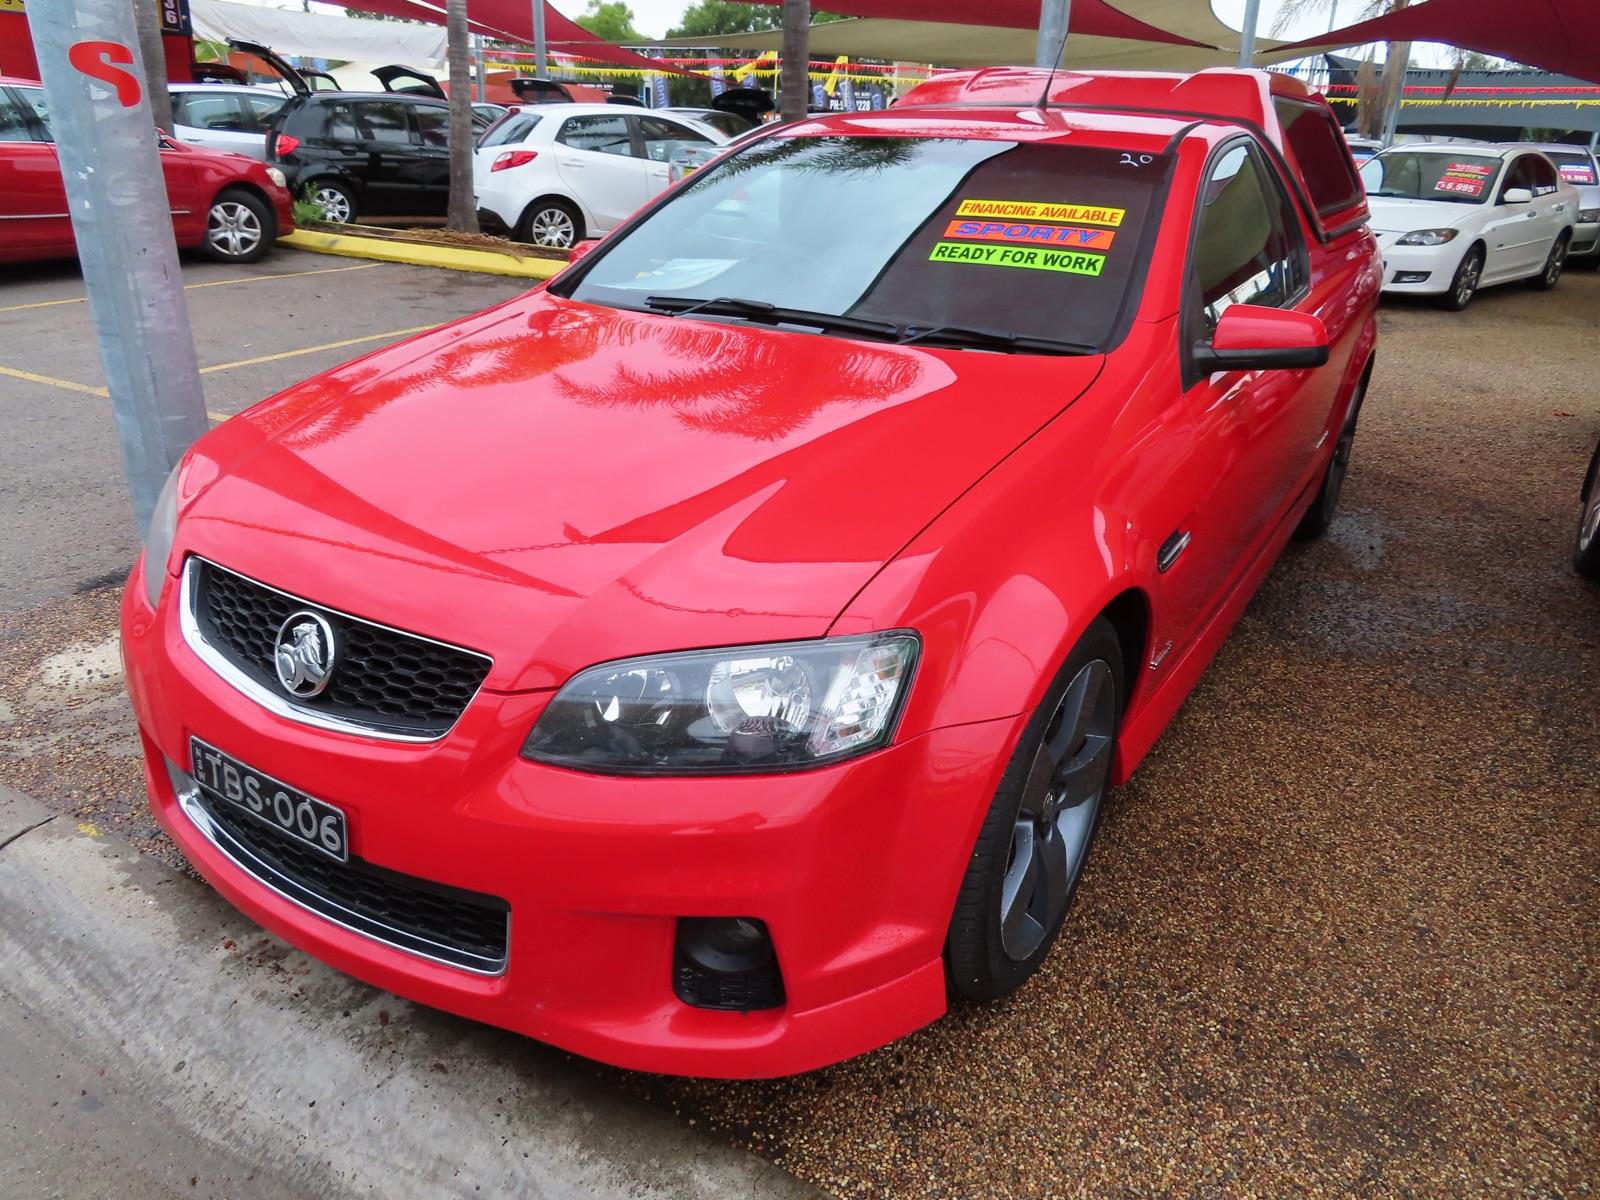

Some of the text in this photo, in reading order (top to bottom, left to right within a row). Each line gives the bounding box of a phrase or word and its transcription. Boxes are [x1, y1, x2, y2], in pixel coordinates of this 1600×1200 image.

[1119, 153, 1153, 167] 20
[961, 203, 1120, 223] FINANCING AVAILABLE
[955, 222, 1104, 243] SPORTY
[935, 246, 1100, 272] READY FOR WORK
